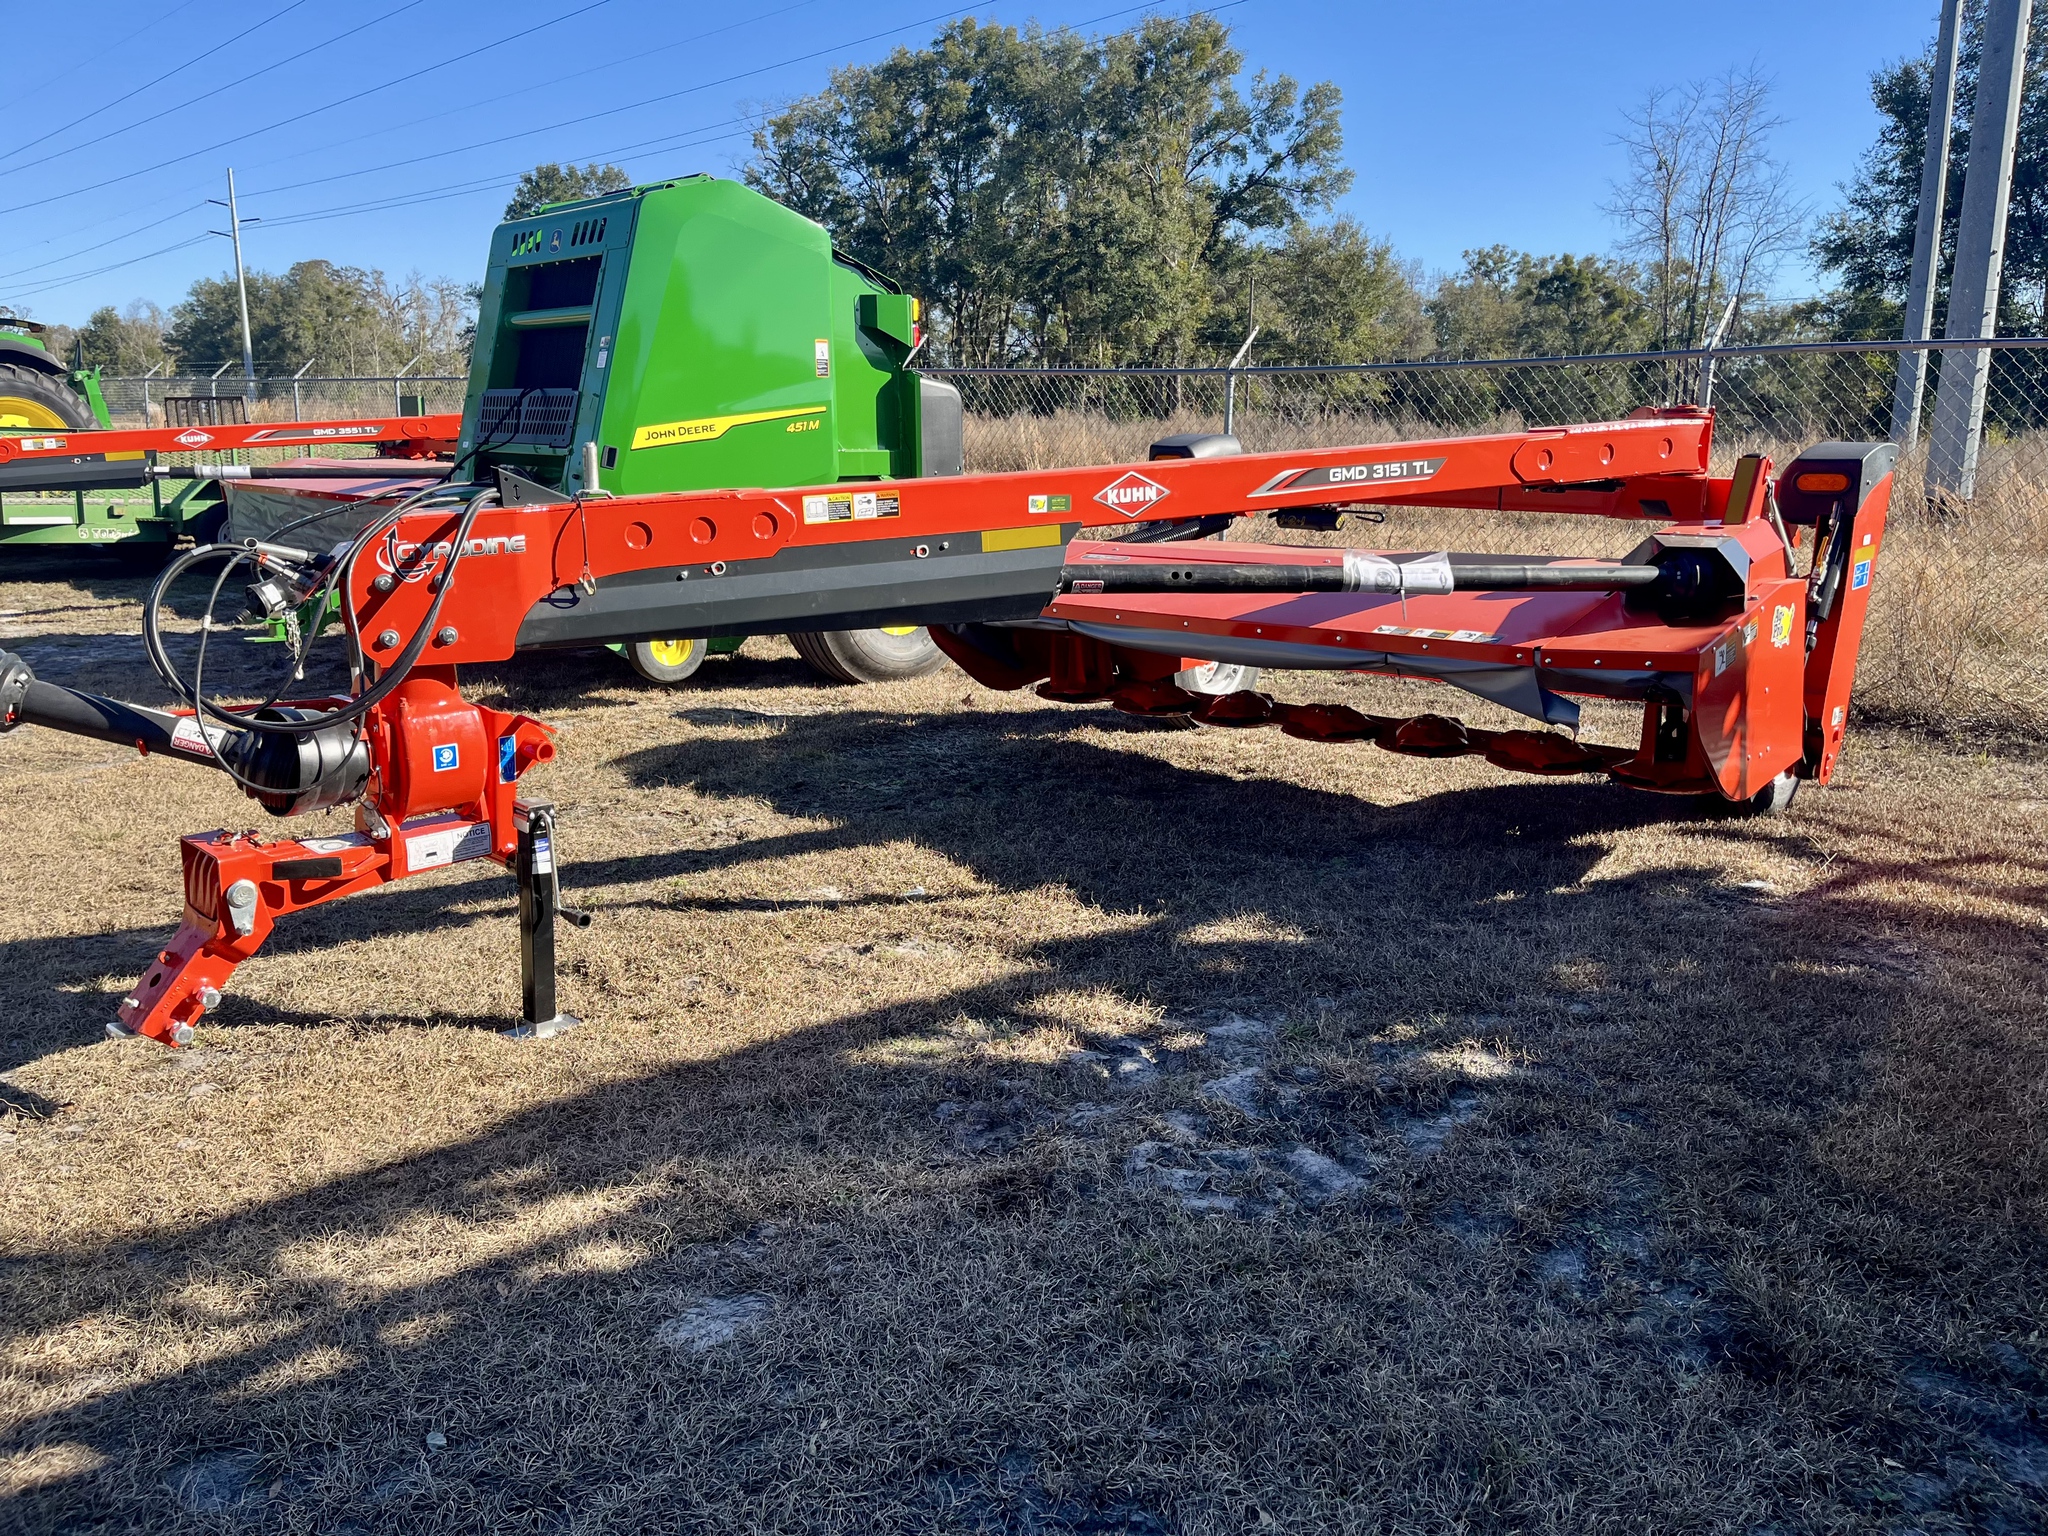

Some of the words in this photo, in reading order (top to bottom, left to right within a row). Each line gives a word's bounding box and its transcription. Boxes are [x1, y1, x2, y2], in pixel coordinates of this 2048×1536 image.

[180, 435, 207, 443] KUHN
[313, 428, 336, 436] GMD
[338, 427, 362, 435] 3551
[645, 430, 676, 440] JOHN
[678, 424, 717, 435] DEERE
[1329, 467, 1368, 482] GMD
[1372, 463, 1408, 478] 3151
[1413, 460, 1434, 474] TL
[1107, 486, 1158, 505] KUHN
[174, 737, 205, 752] DANGER
[456, 827, 486, 839] NOTICE
